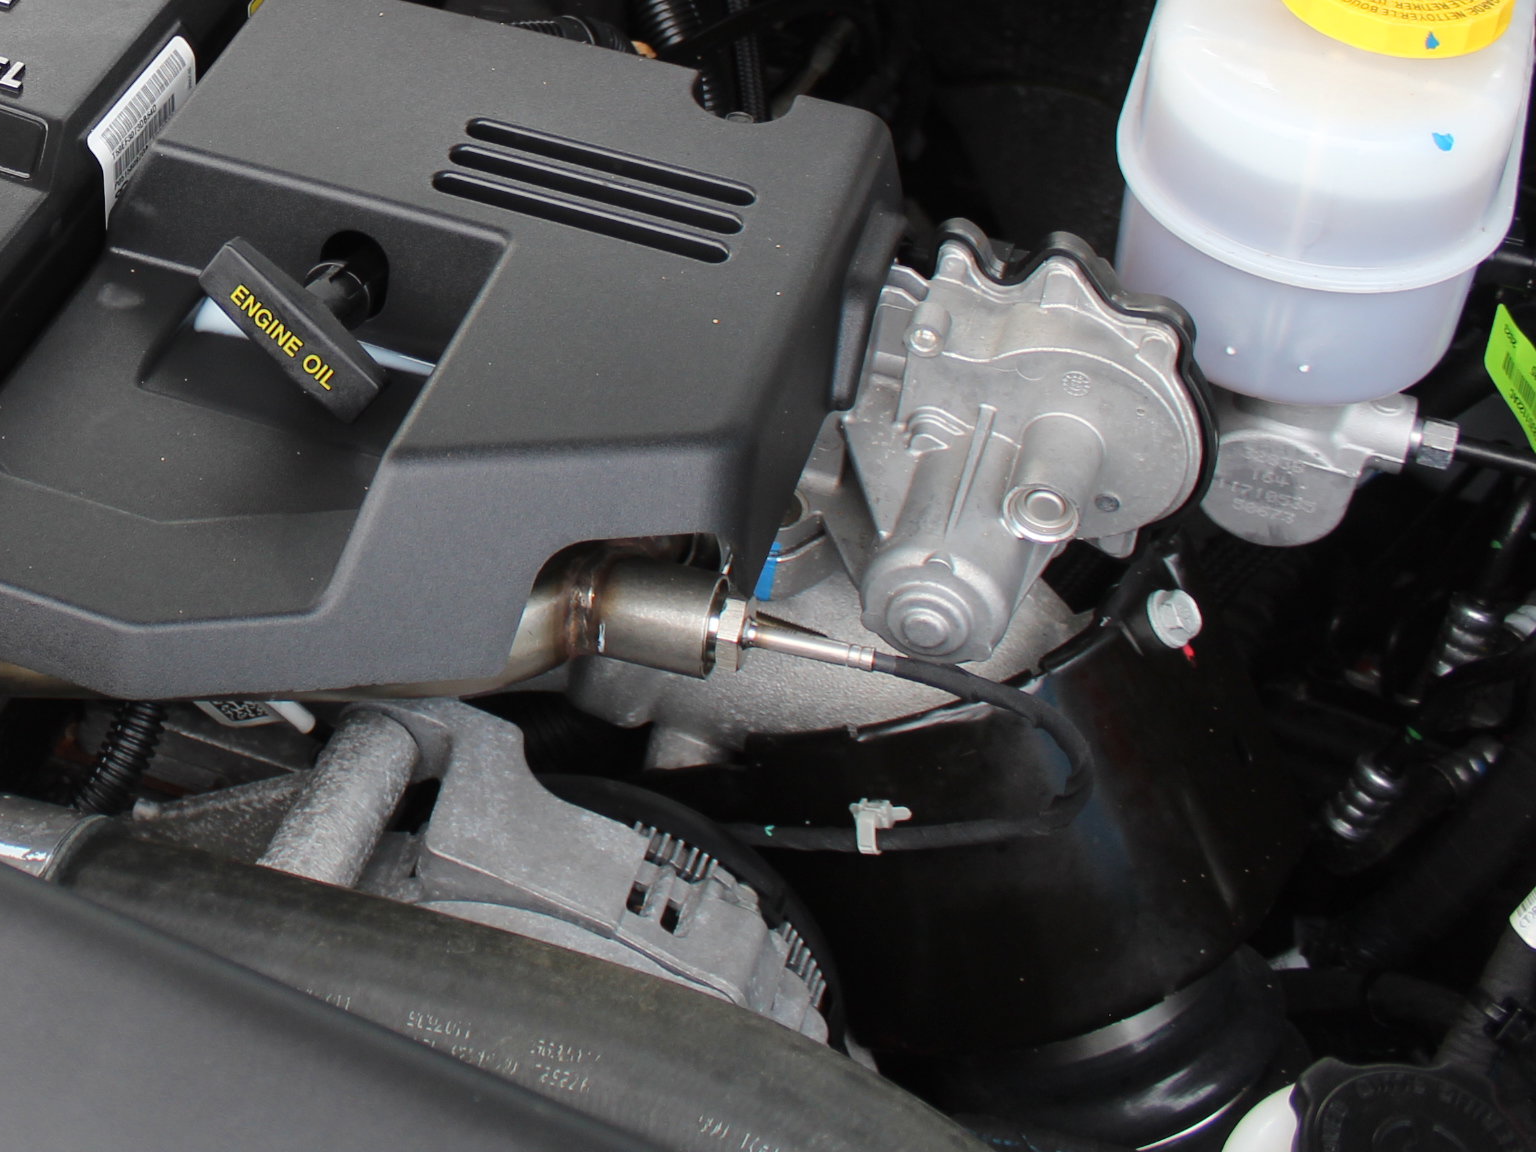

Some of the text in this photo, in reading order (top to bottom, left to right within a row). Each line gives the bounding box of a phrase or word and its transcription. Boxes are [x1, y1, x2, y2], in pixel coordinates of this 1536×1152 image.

[1380, 8, 1397, 17] LE
[1401, 10, 1467, 21] NETTOYER
[230, 284, 336, 391] ENGINE OIL
